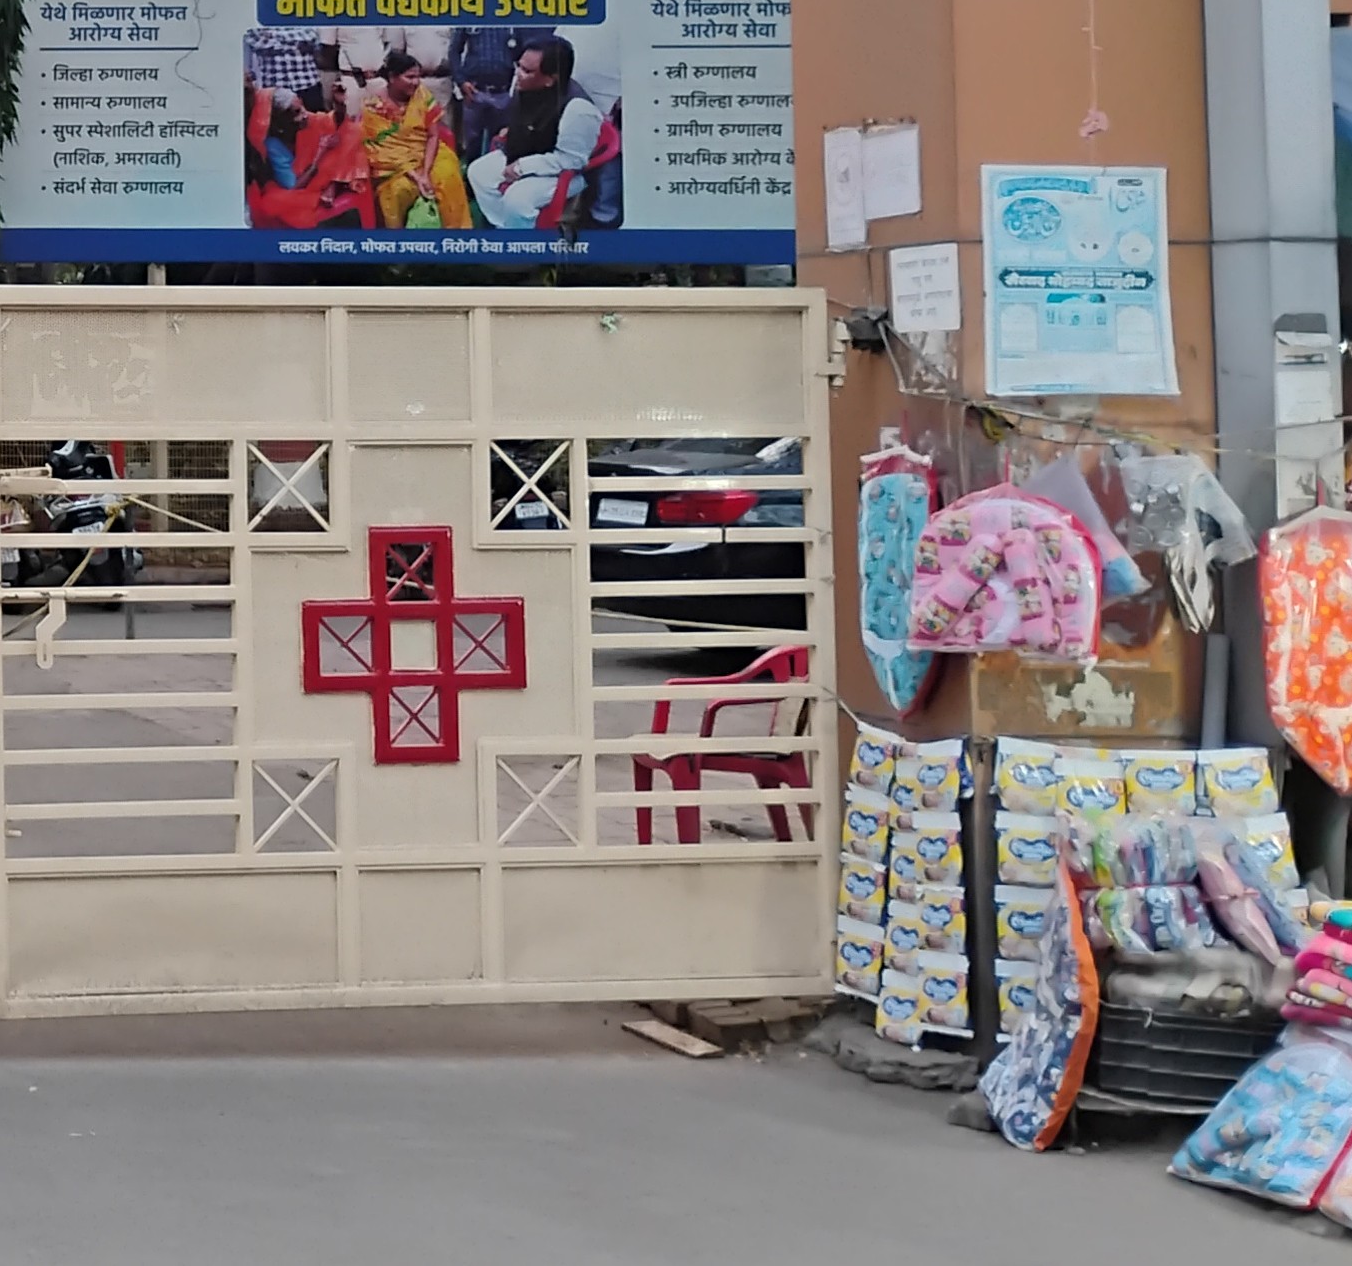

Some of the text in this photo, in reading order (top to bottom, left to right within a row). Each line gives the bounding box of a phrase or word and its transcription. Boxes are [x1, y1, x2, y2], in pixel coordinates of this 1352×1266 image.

[40, 2, 188, 22] येथे मिळणार मोफत
[69, 23, 160, 42] आरोग्य सेवा
[682, 19, 777, 38] आरोग्य सेवा
[53, 64, 159, 83] जिल्हा रुग्णालय
[665, 62, 757, 80] स्त्री रुग्णालय
[52, 95, 167, 111] सामान्य रुग्णालय
[670, 90, 794, 109] उपजिल्हा रुग्णाल
[52, 120, 219, 143] सुपर स्पेशालिटी हॉस्पिटल
[666, 120, 783, 138] ग्रामीण रुग्णालय
[53, 148, 182, 169] (नाशिक, अमरावती)
[666, 148, 727, 167] प्राथमिक
[731, 148, 781, 166] आरोग्य
[52, 177, 184, 196] संदर्भ सेवा रुग्णालय
[668, 176, 761, 196] आरोग्यवर्धिनी
[360, 237, 396, 253] मोफत
[441, 237, 478, 254] निरोगी
[506, 240, 546, 254] आपला
